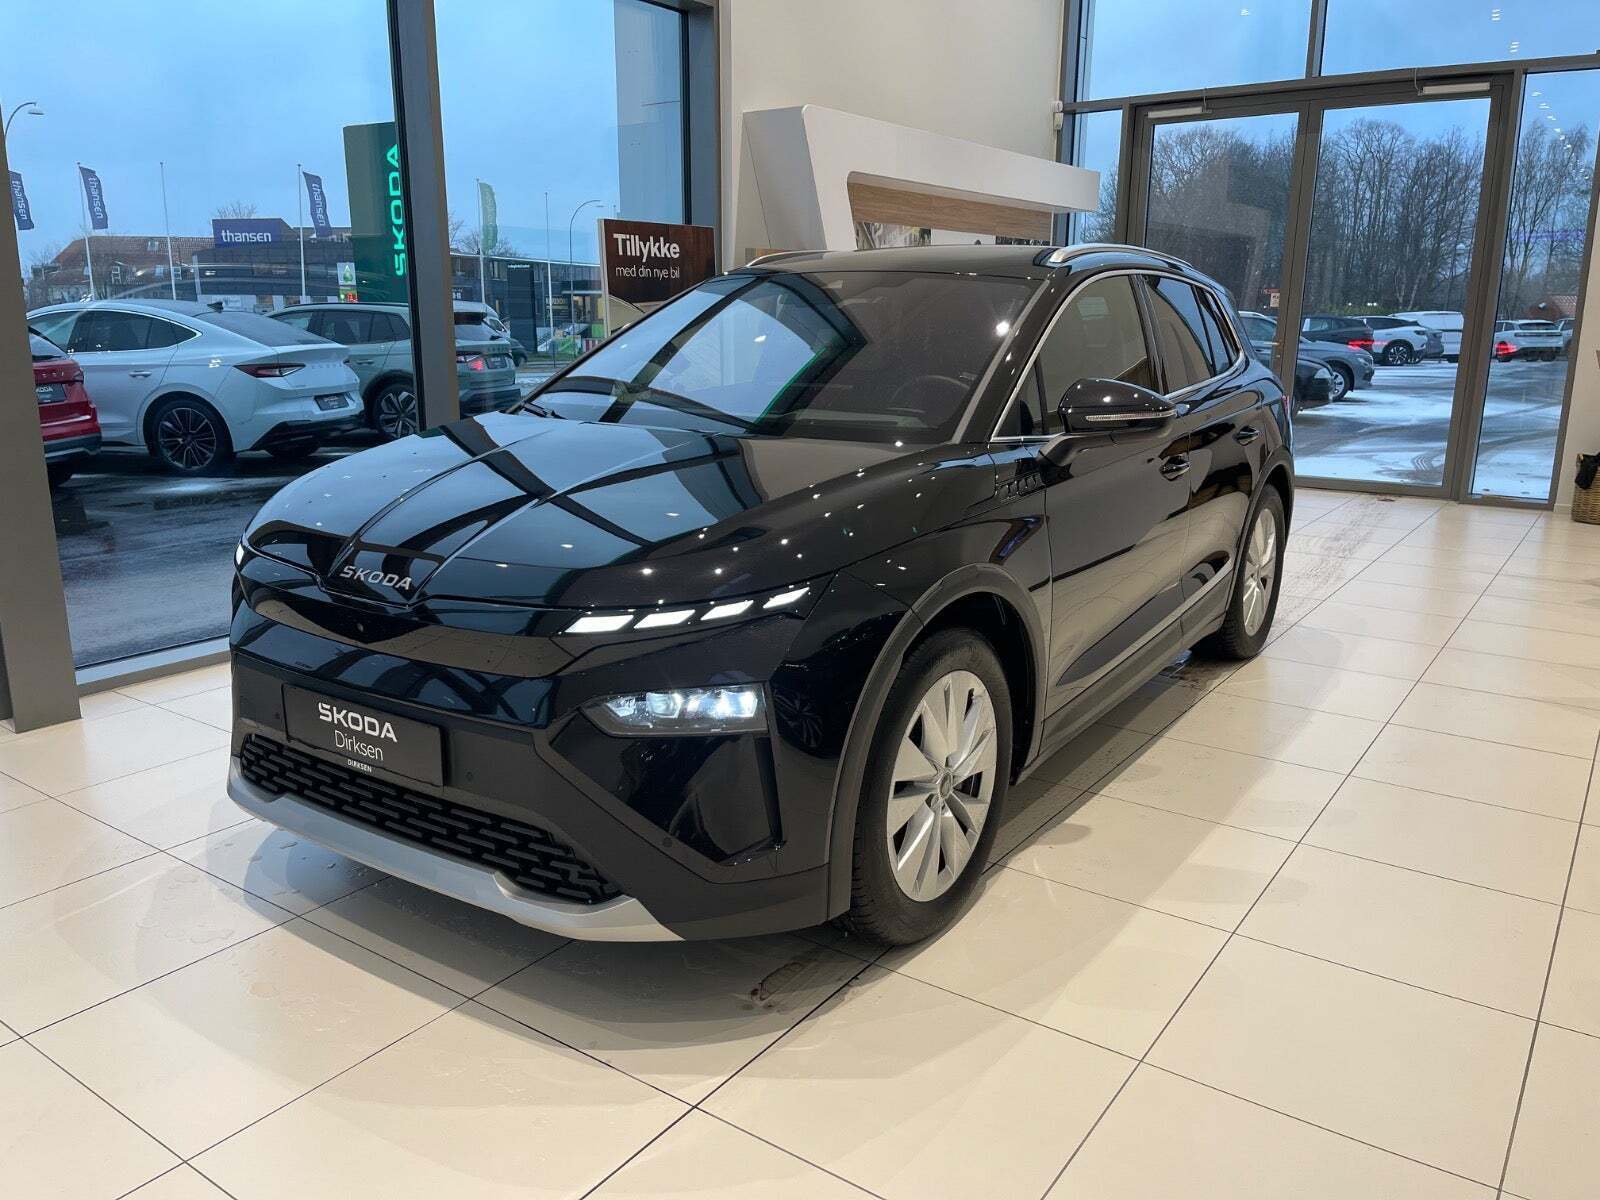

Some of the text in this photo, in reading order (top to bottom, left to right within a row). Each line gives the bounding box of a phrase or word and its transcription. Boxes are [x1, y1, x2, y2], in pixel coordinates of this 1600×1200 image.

[11, 180, 28, 220] thansen
[88, 176, 104, 219] thansen
[311, 183, 326, 226] thansen
[221, 229, 272, 243] thansen
[613, 233, 680, 262] Tillykke
[615, 265, 680, 280] med din nye bil
[340, 565, 412, 590] SKODA
[318, 702, 398, 742] SKODA
[334, 729, 384, 761] Dirksen
[347, 759, 372, 773] DIRKSEN
